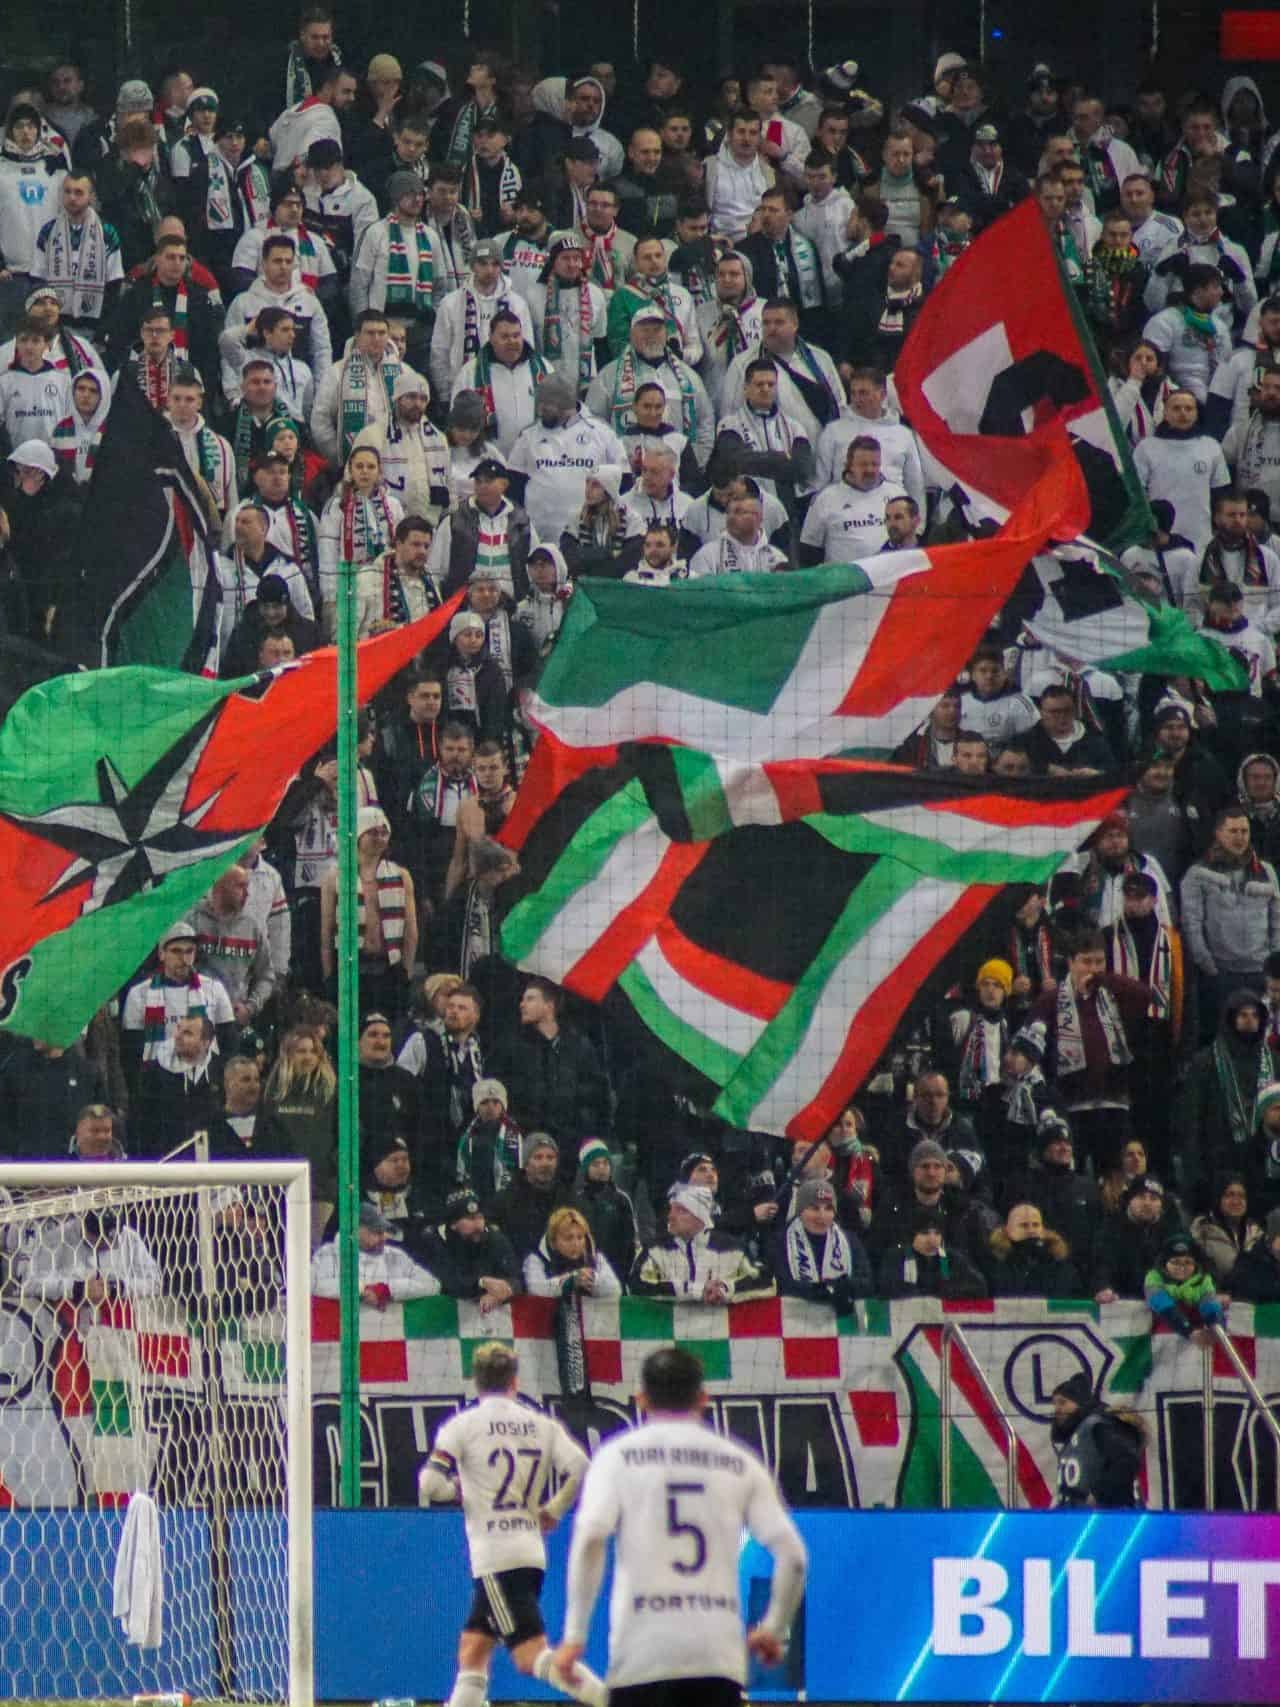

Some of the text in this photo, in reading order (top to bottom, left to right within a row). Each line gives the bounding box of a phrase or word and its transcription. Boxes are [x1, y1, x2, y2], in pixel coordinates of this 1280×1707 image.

[487, 1447, 543, 1511] 27
[665, 1482, 707, 1575] 5
[932, 1556, 1280, 1659] BILET
